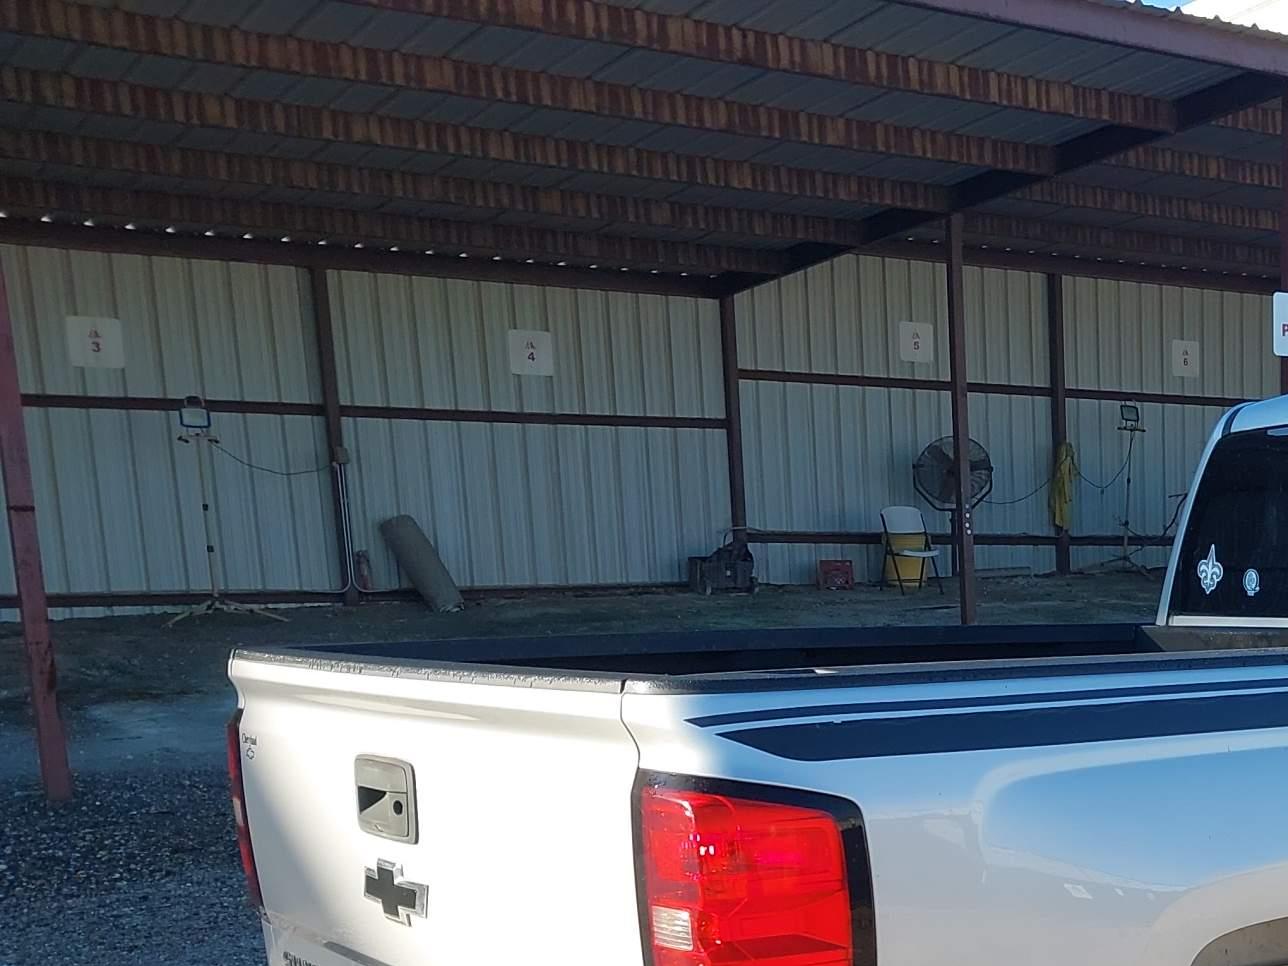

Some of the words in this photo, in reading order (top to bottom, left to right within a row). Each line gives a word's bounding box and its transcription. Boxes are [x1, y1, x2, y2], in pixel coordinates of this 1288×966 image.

[91, 341, 102, 352] 3
[913, 341, 920, 350] 5
[527, 352, 536, 361] 4
